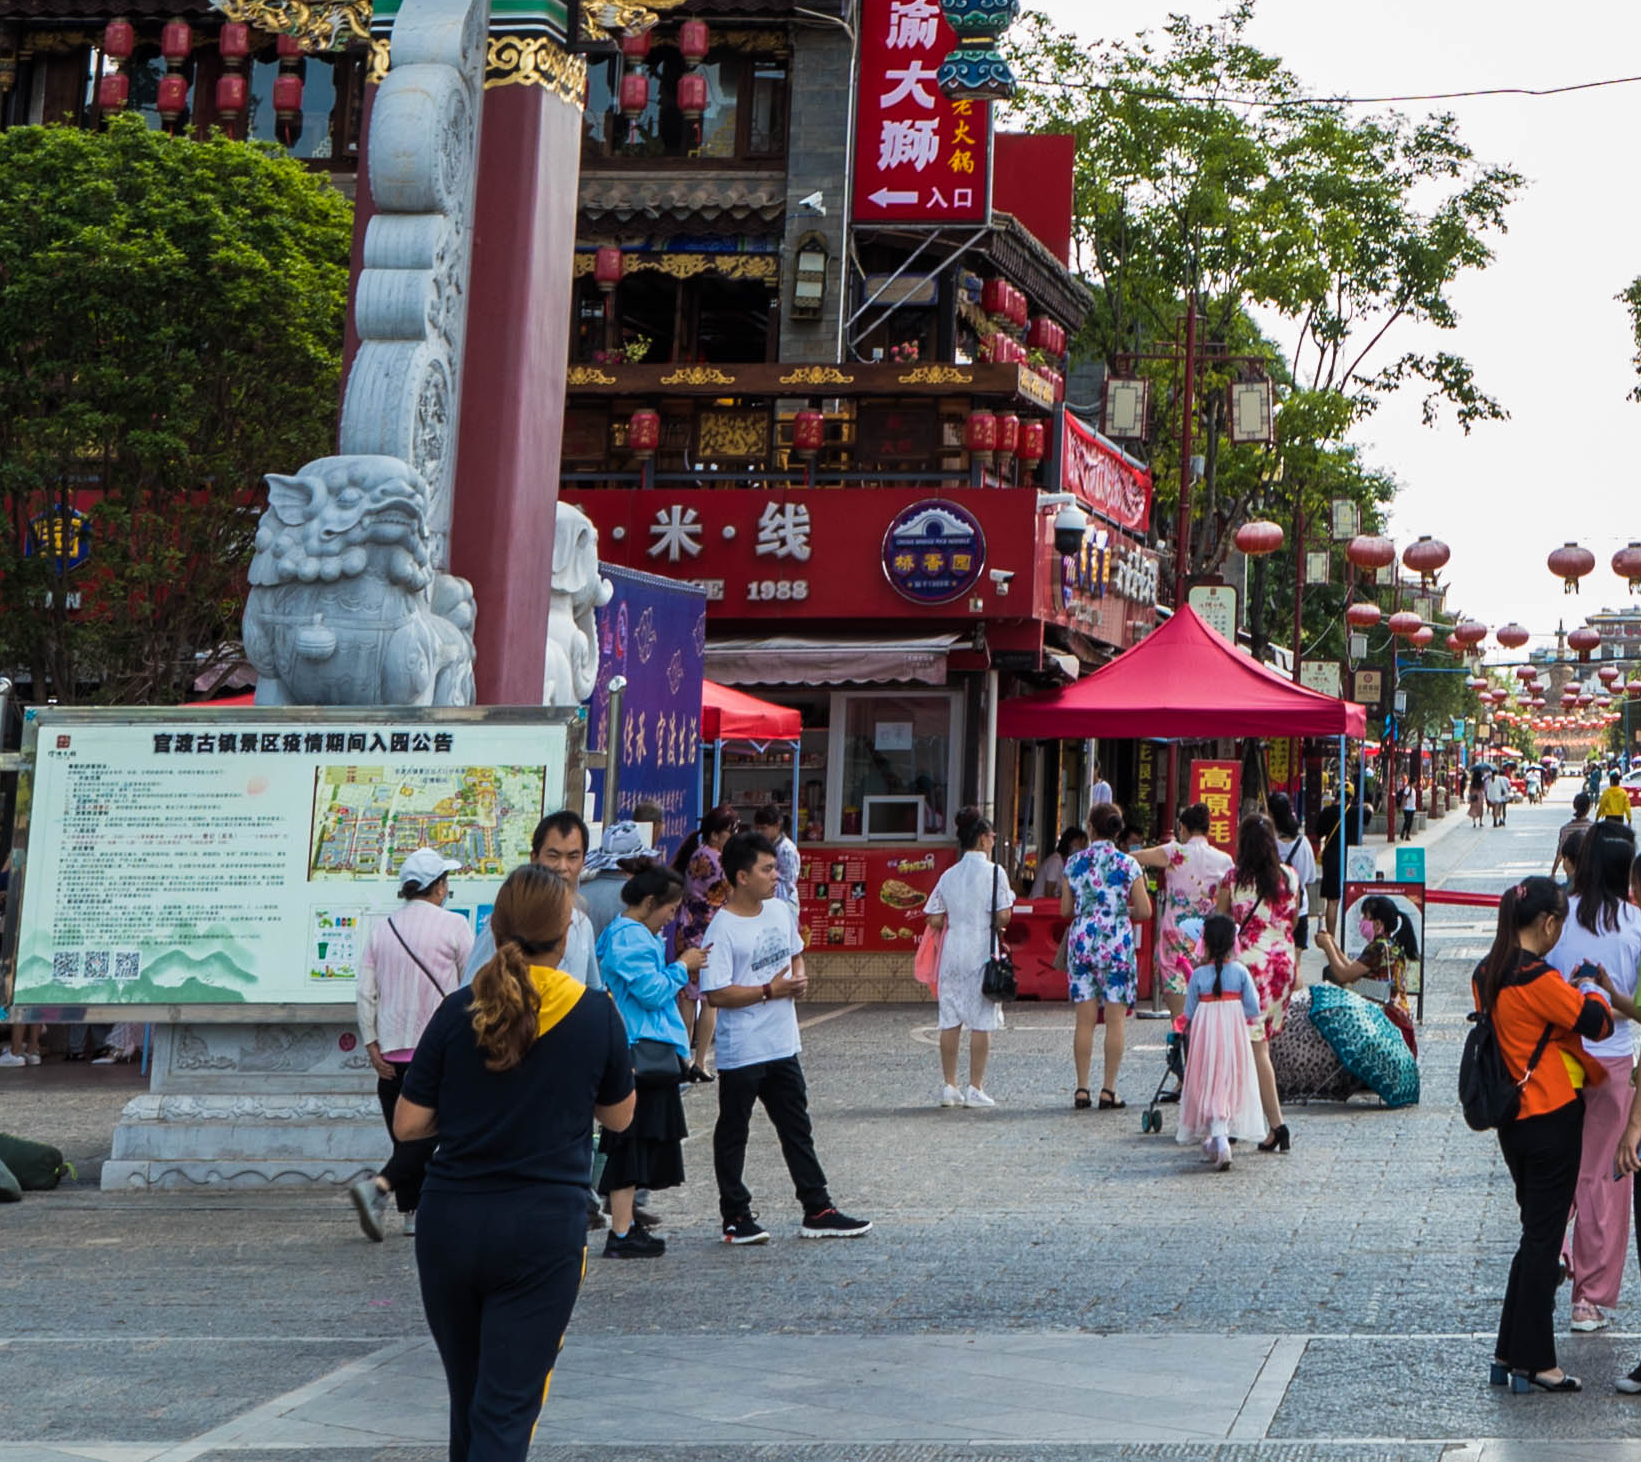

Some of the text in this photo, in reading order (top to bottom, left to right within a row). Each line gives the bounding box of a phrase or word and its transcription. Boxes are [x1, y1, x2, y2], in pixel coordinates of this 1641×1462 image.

[925, 186, 973, 208] 入口
[747, 580, 809, 601] 1988
[152, 732, 454, 755] 官渡古镇景区疫情期间入园公告
